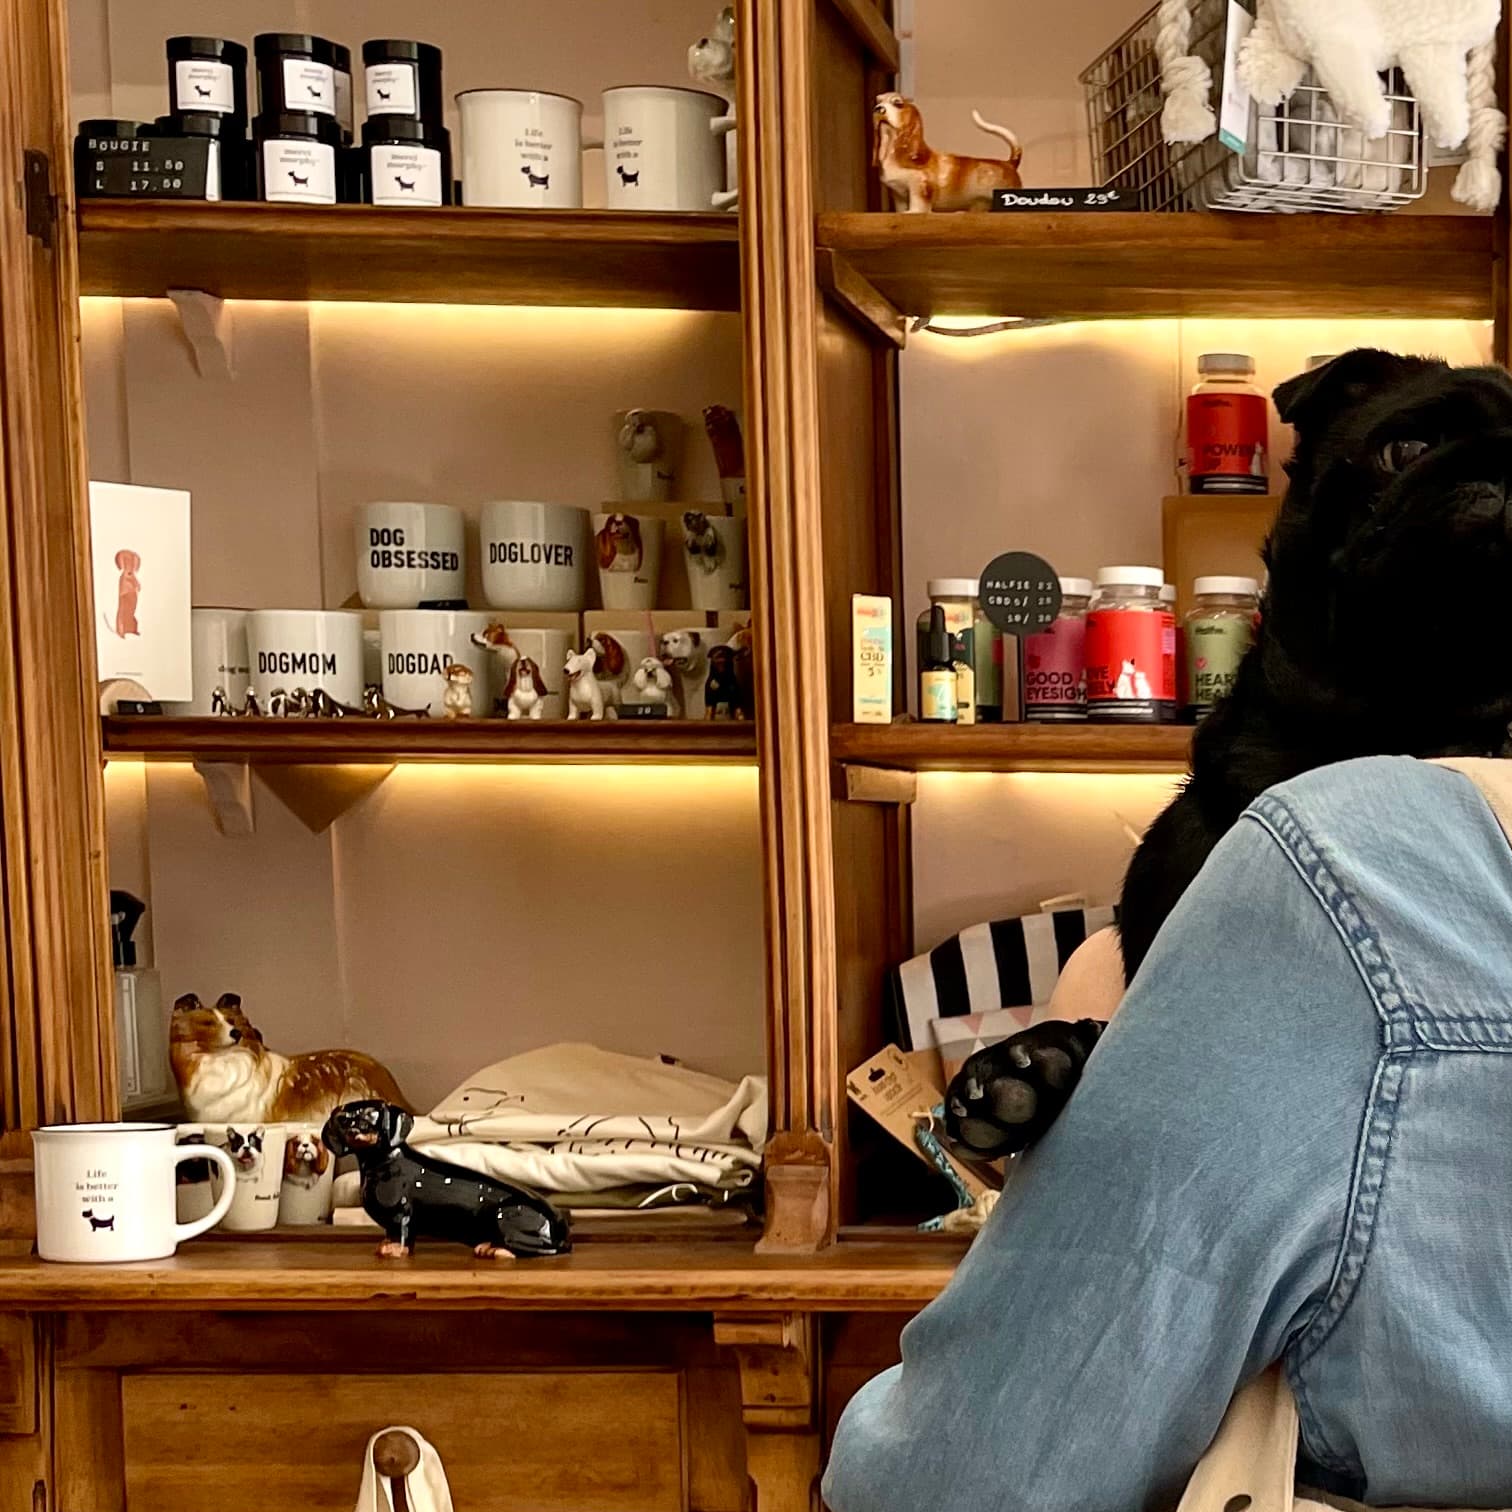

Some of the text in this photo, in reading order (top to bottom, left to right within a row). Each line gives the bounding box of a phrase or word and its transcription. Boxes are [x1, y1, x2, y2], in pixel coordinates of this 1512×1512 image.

[88, 139, 150, 151] BOUGIE
[96, 179, 104, 189] L
[1001, 192, 1074, 206] Doudou
[370, 527, 405, 547] DOG
[371, 549, 459, 571] OBSESSED
[489, 542, 574, 567] DOGLOVER
[258, 651, 338, 675] DOGMOM
[1025, 672, 1073, 685] GOOD
